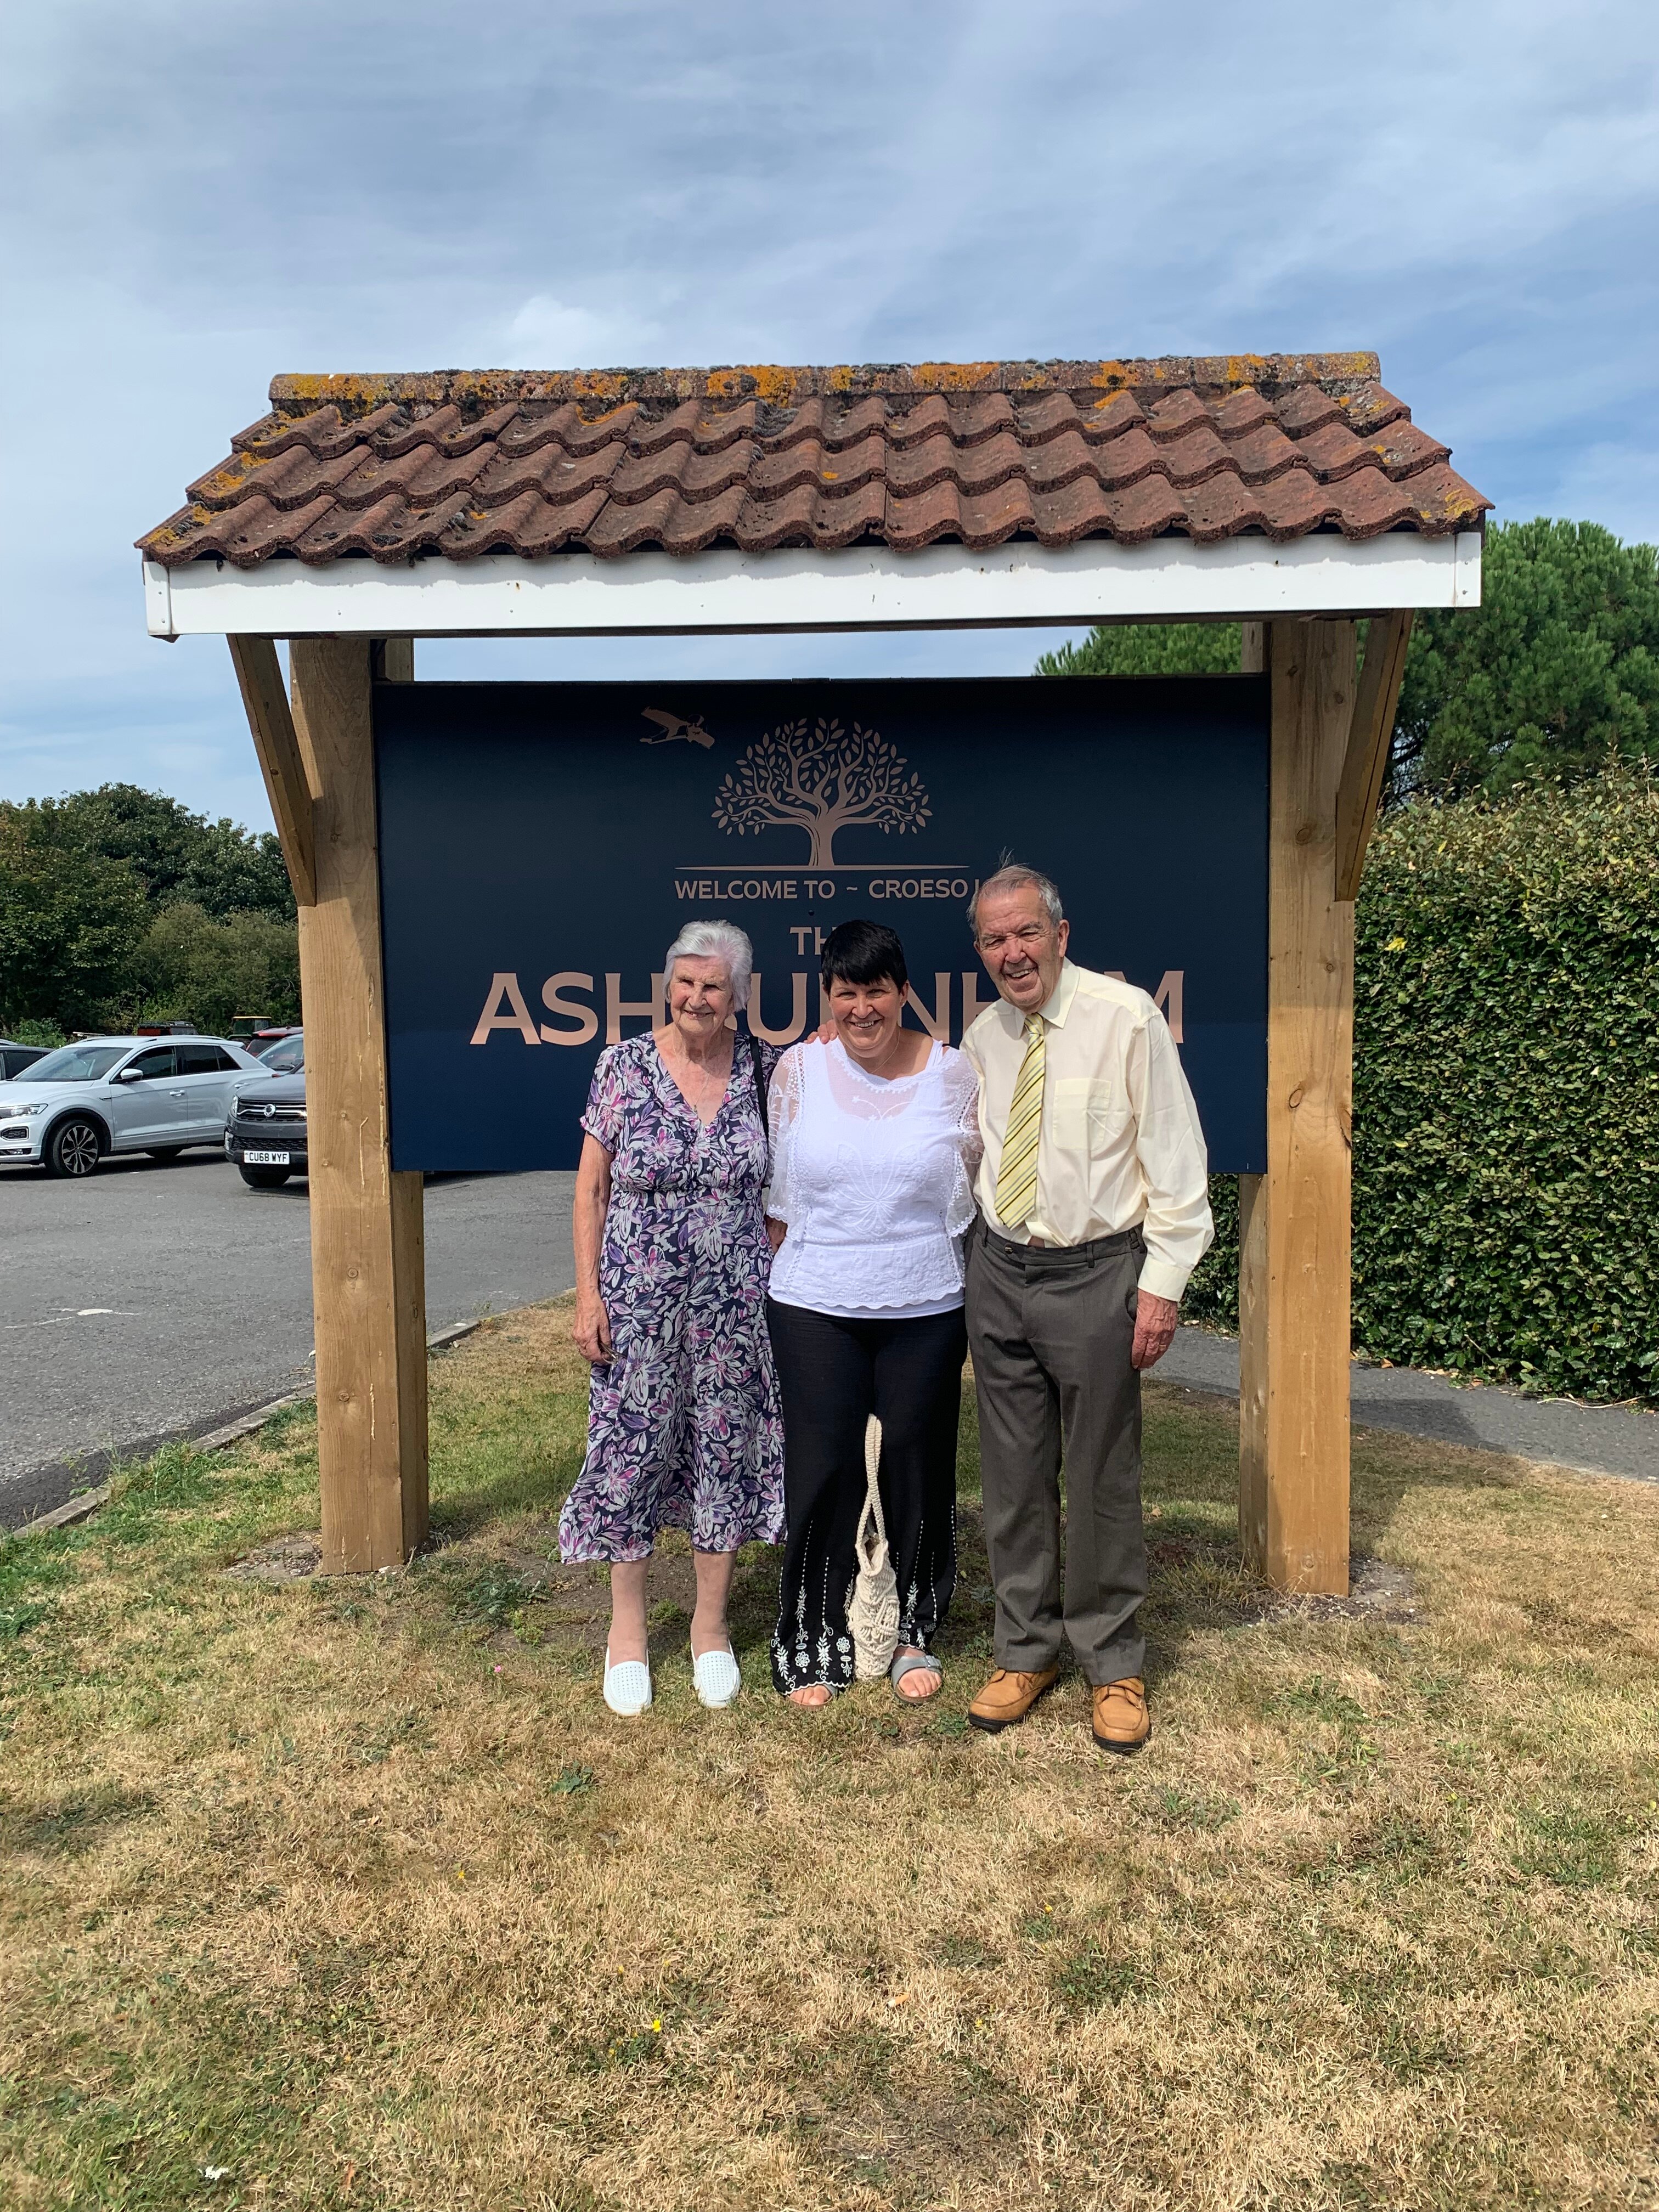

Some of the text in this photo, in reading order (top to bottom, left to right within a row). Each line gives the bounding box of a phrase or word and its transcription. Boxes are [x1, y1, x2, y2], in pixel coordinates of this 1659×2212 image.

[675, 880, 797, 899] WELCOME
[804, 880, 836, 899] TO
[868, 879, 968, 899] CROESO
[249, 1152, 287, 1163] CU68 WYF
